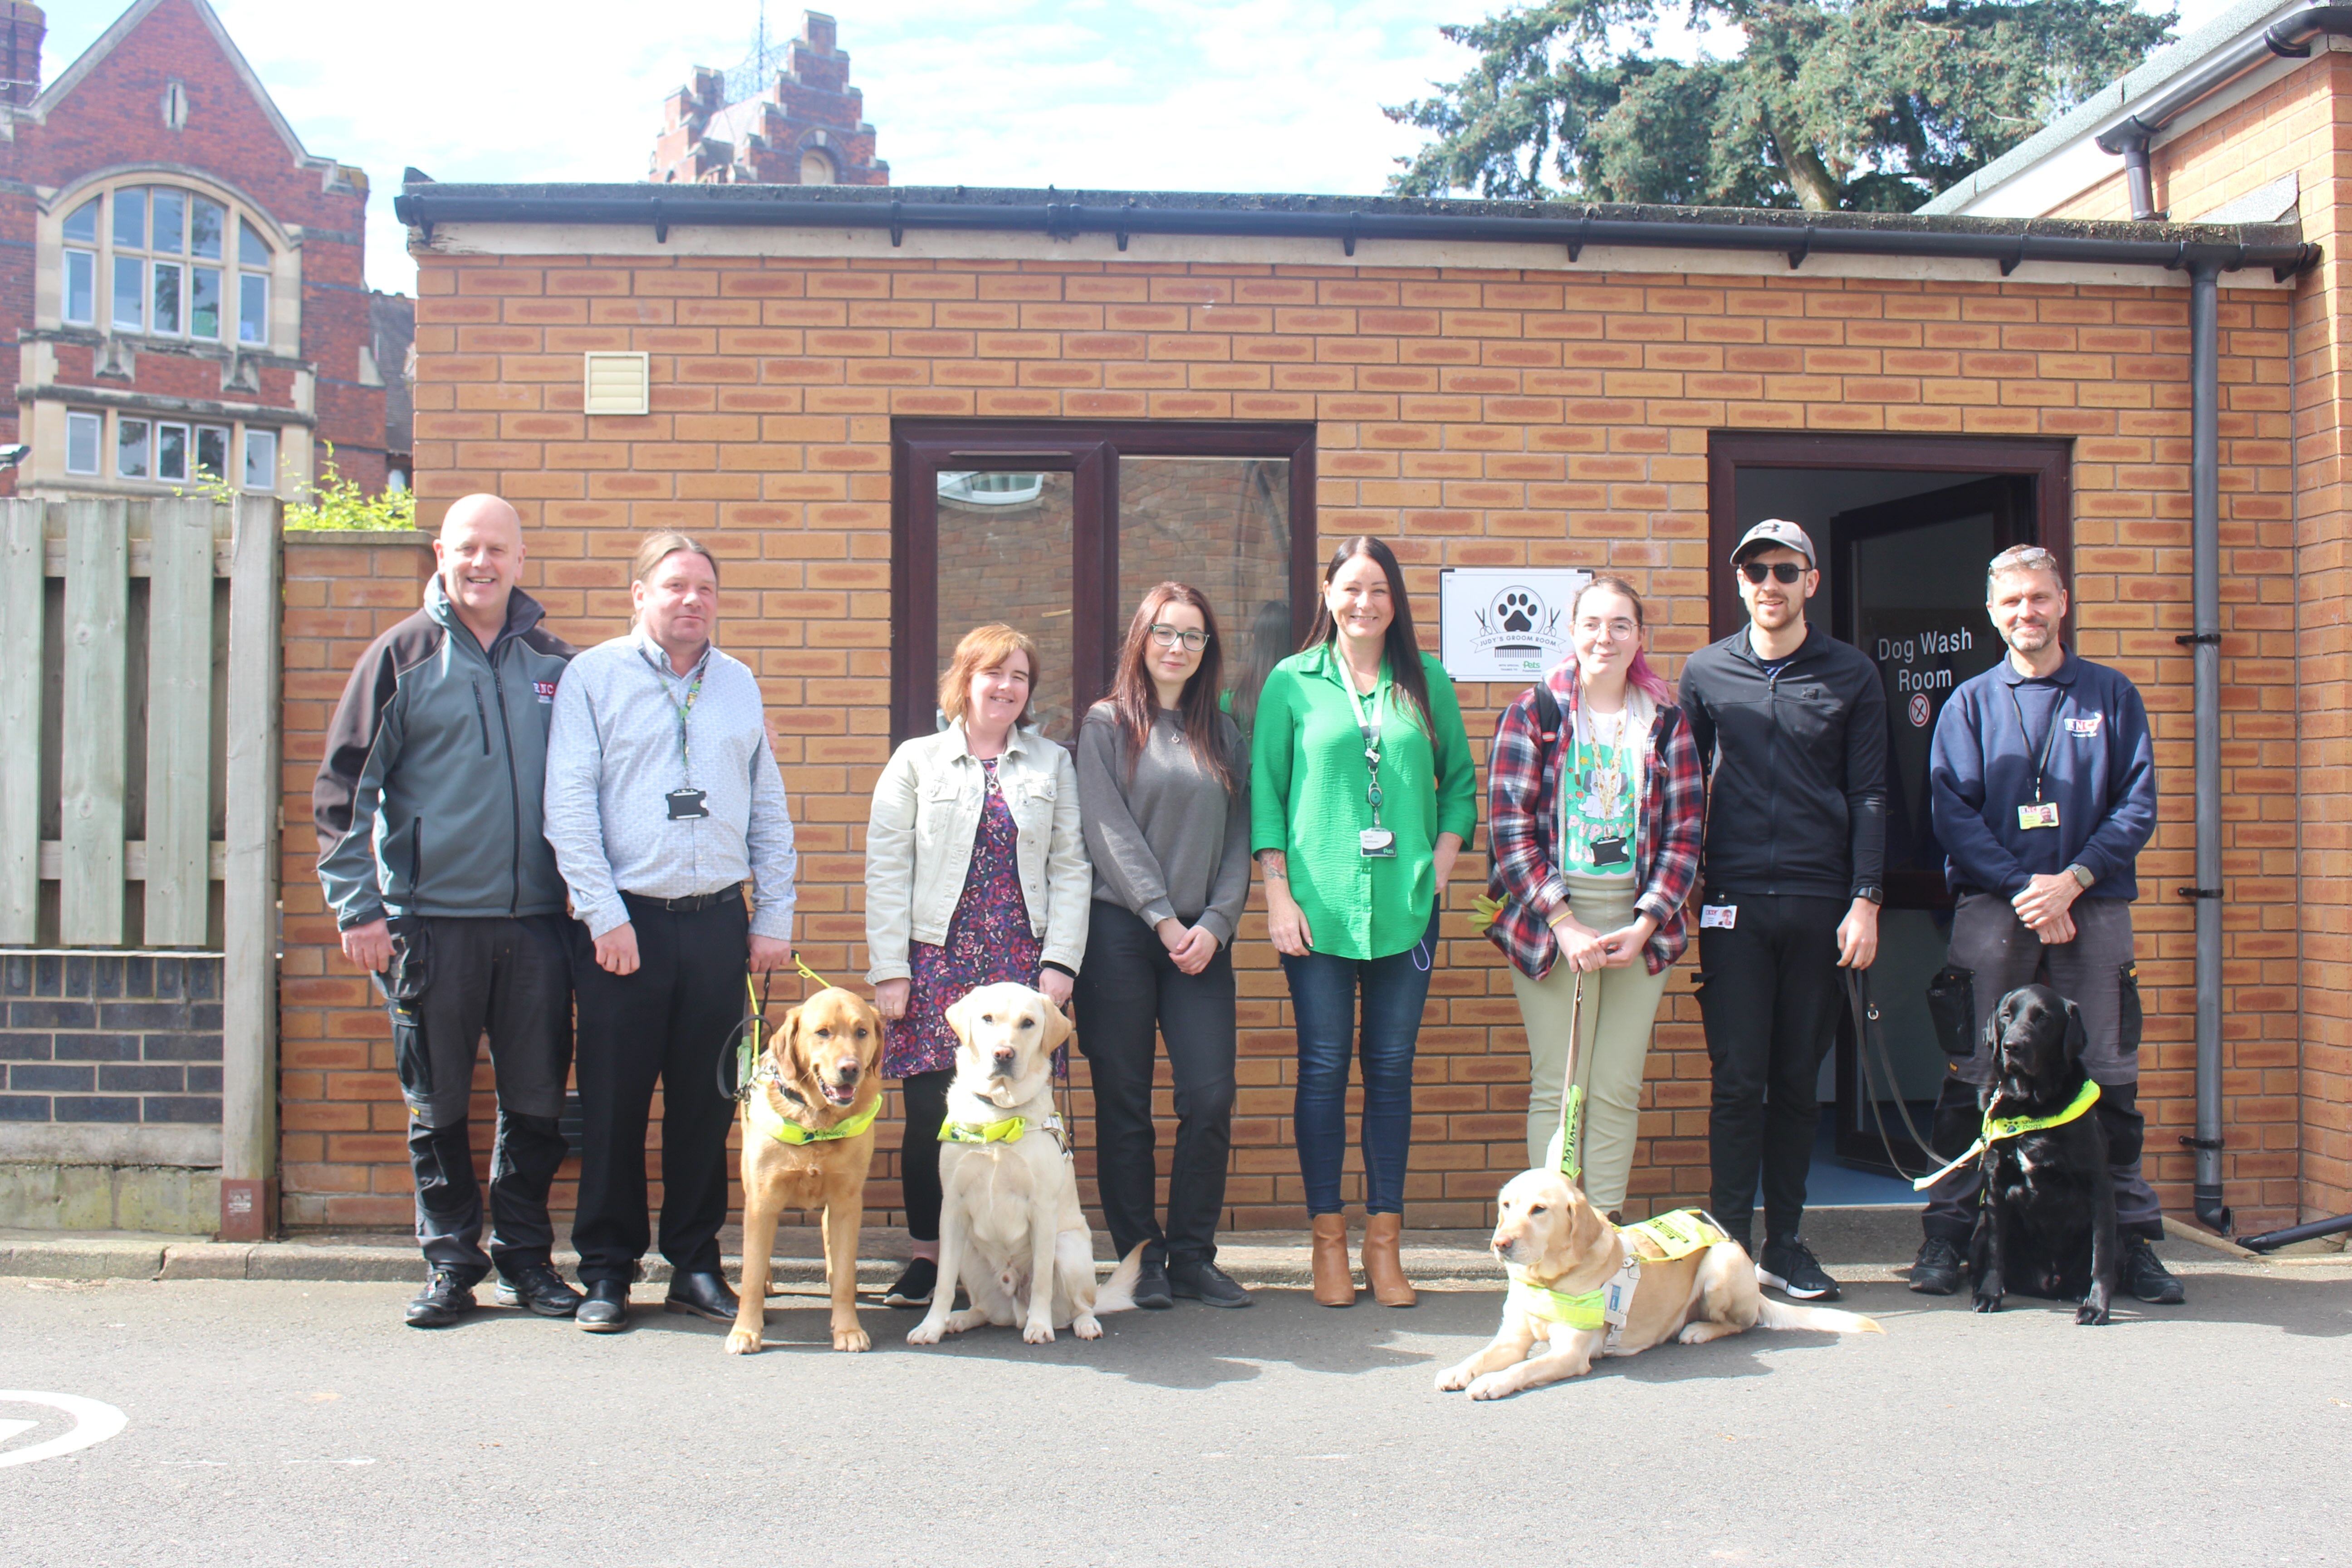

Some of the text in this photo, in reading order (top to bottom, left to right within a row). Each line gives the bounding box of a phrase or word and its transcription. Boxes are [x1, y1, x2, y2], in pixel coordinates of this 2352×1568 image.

[1480, 636, 1504, 647] JUDY'S
[1535, 637, 1556, 647] ROOM
[1878, 626, 1972, 664] Dog Wash
[1523, 660, 1540, 669] Pets
[1898, 669, 1952, 692] Room
